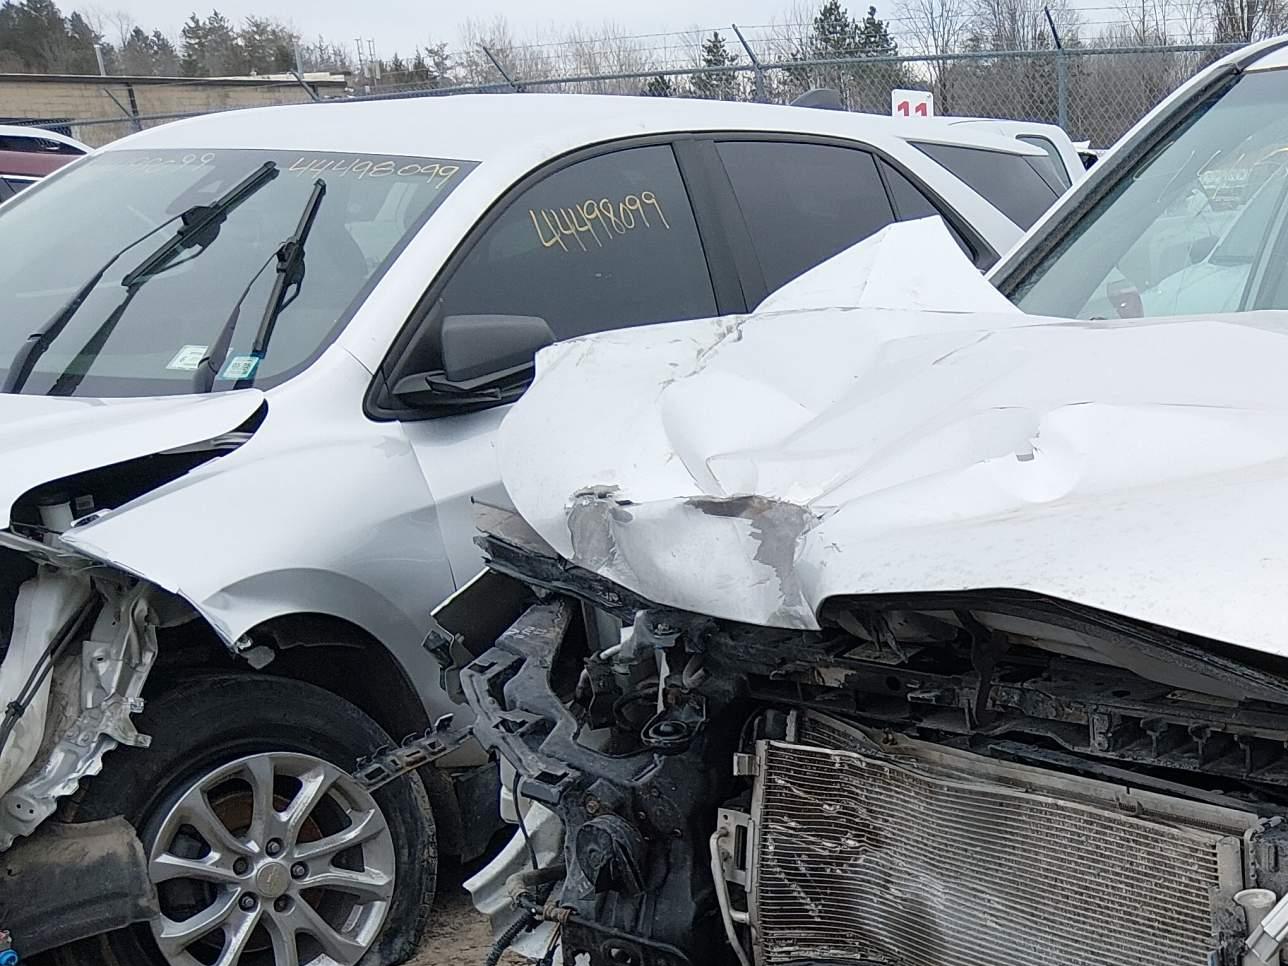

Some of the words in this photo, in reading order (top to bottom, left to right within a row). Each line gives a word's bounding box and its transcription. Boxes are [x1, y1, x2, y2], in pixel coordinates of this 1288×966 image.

[897, 100, 928, 117] 11
[289, 157, 459, 190] 44498099
[529, 191, 670, 252] 44498099
